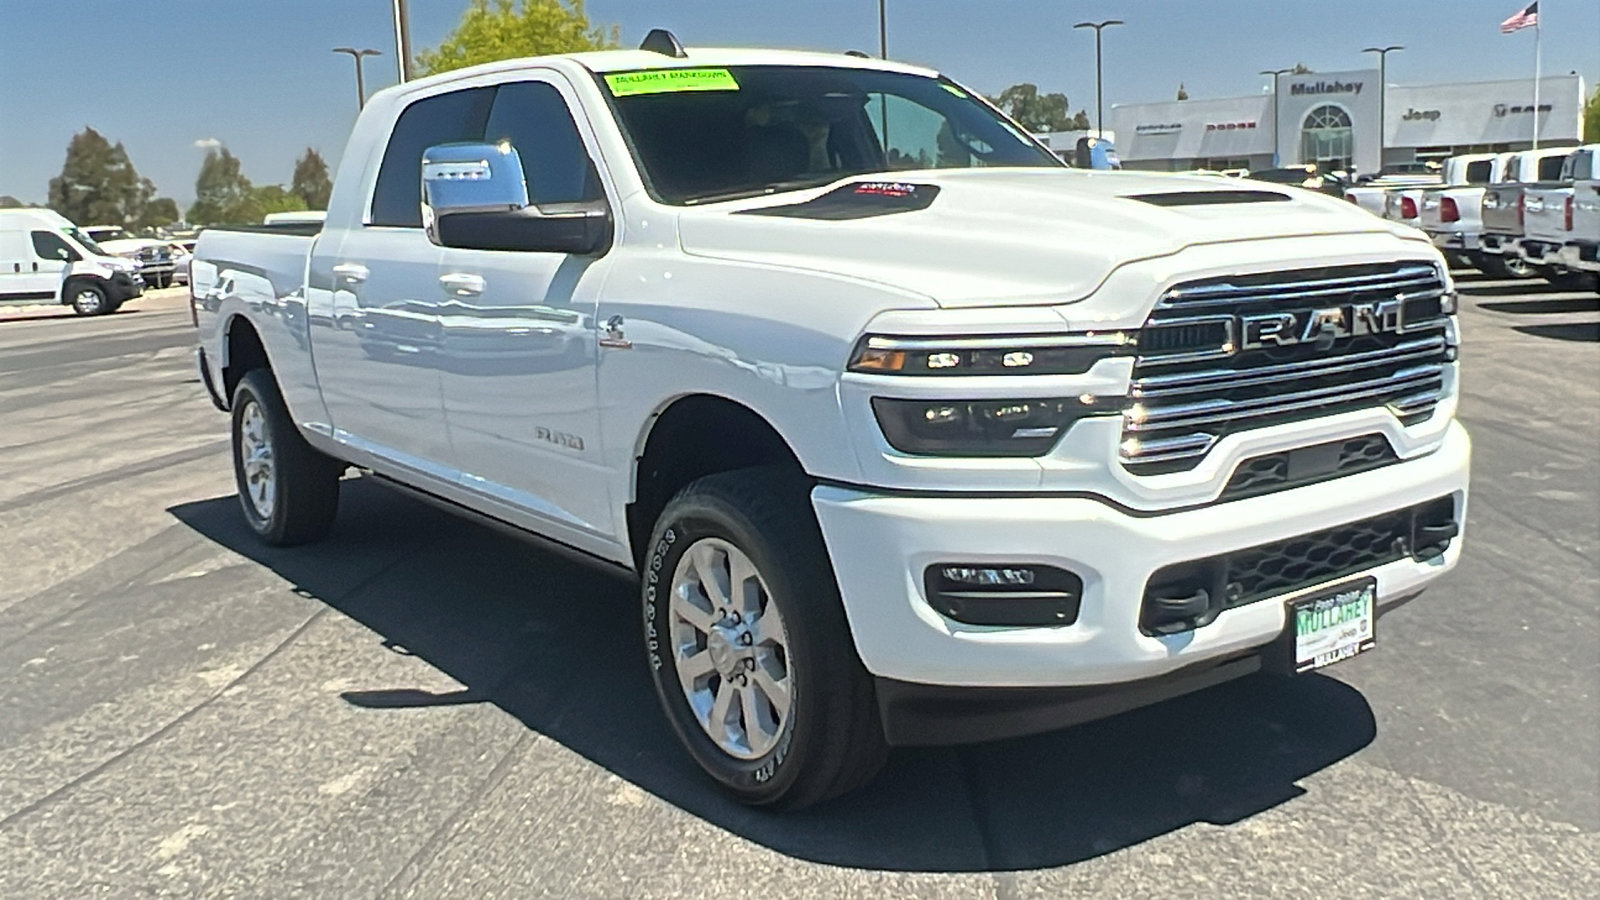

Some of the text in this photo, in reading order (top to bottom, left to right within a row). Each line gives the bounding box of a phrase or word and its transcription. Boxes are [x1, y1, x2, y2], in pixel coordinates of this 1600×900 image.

[1291, 80, 1364, 95] Mullahey
[1402, 108, 1442, 121] Jeep
[1242, 299, 1404, 350] RAM
[535, 426, 585, 451] RAM
[1297, 591, 1371, 636] MULLAHEY
